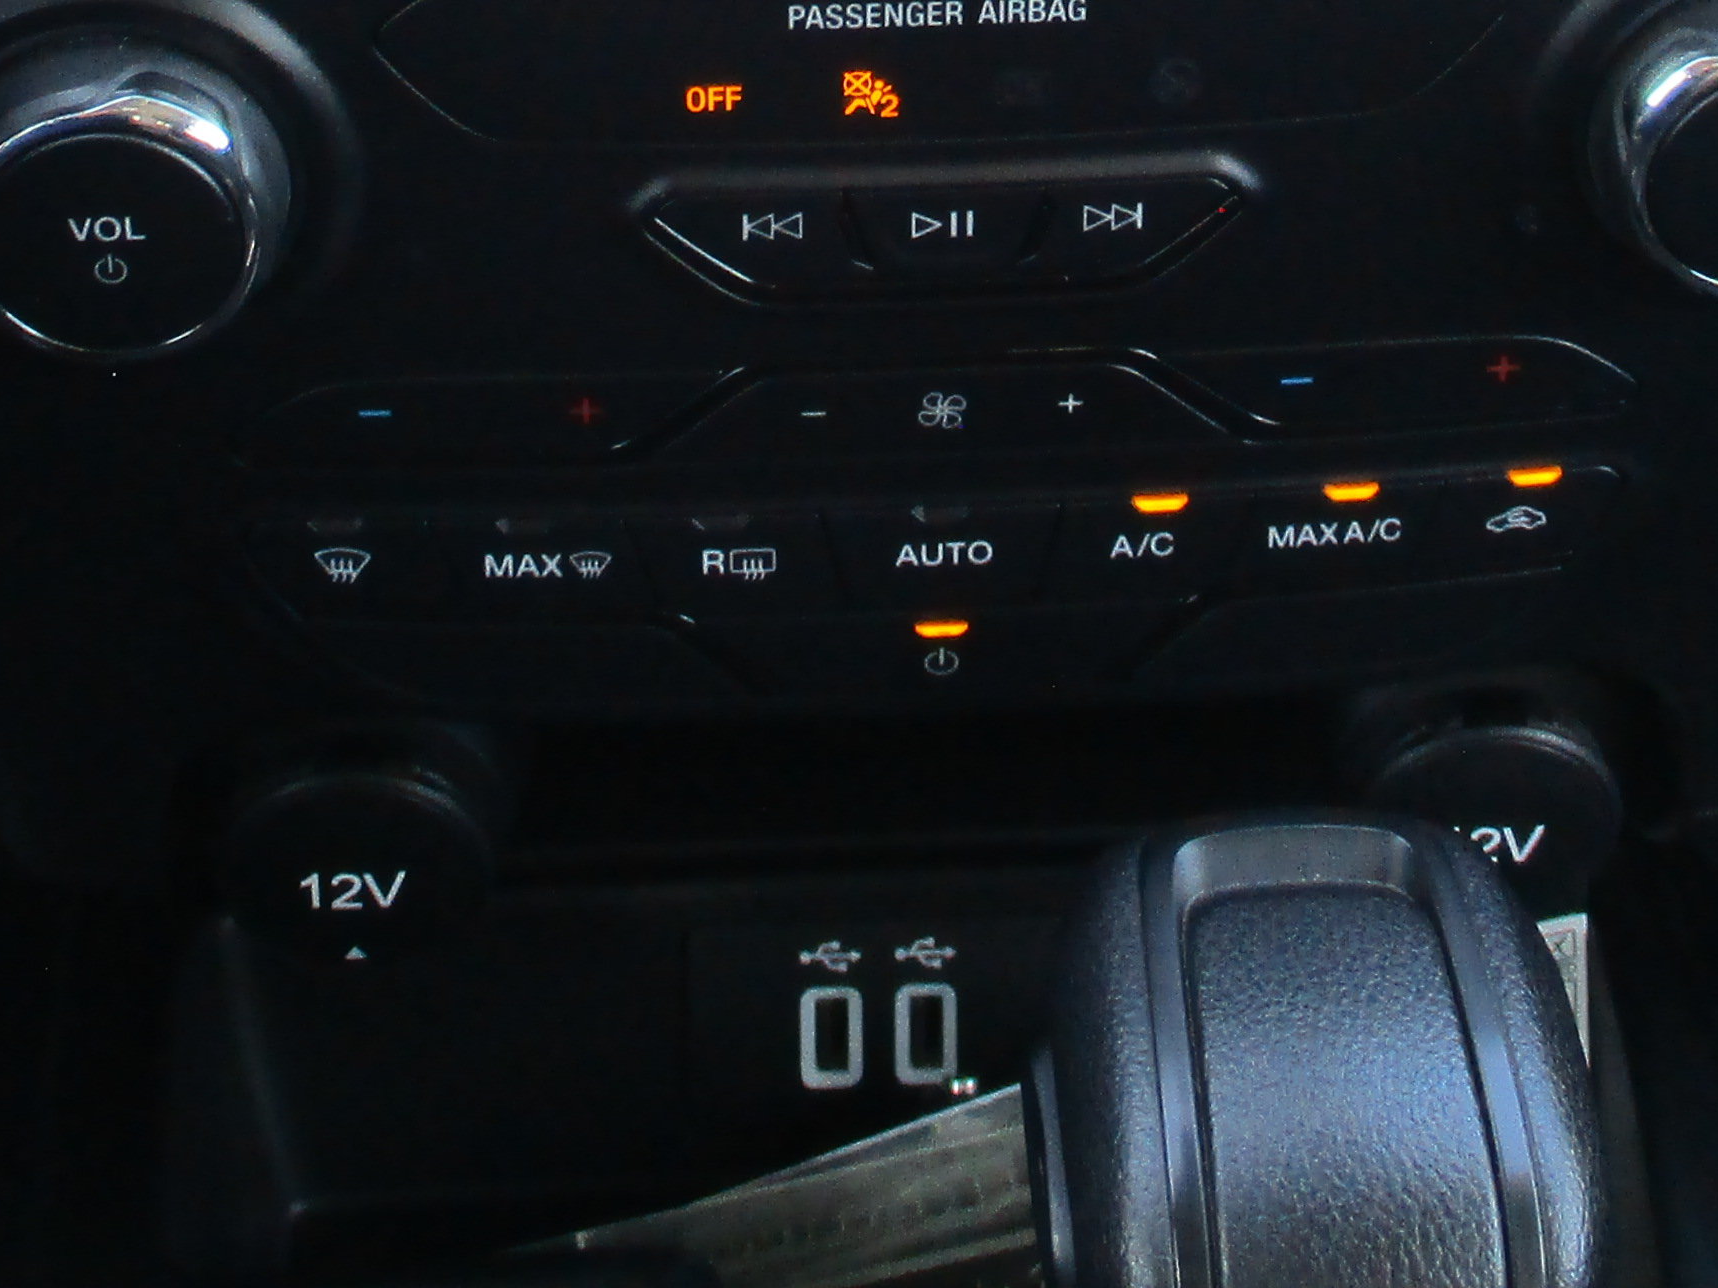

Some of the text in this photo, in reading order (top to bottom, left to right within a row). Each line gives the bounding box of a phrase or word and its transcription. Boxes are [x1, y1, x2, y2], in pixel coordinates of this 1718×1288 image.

[788, 0, 963, 30] PASSENGER
[685, 84, 743, 113] OFF
[68, 216, 146, 242] VOL
[895, 540, 993, 567] AUTO
[1110, 531, 1174, 559] A/C
[484, 553, 562, 578] MAX
[702, 549, 725, 575] R
[1454, 824, 1546, 863] 2V
[300, 870, 406, 910] 12V
